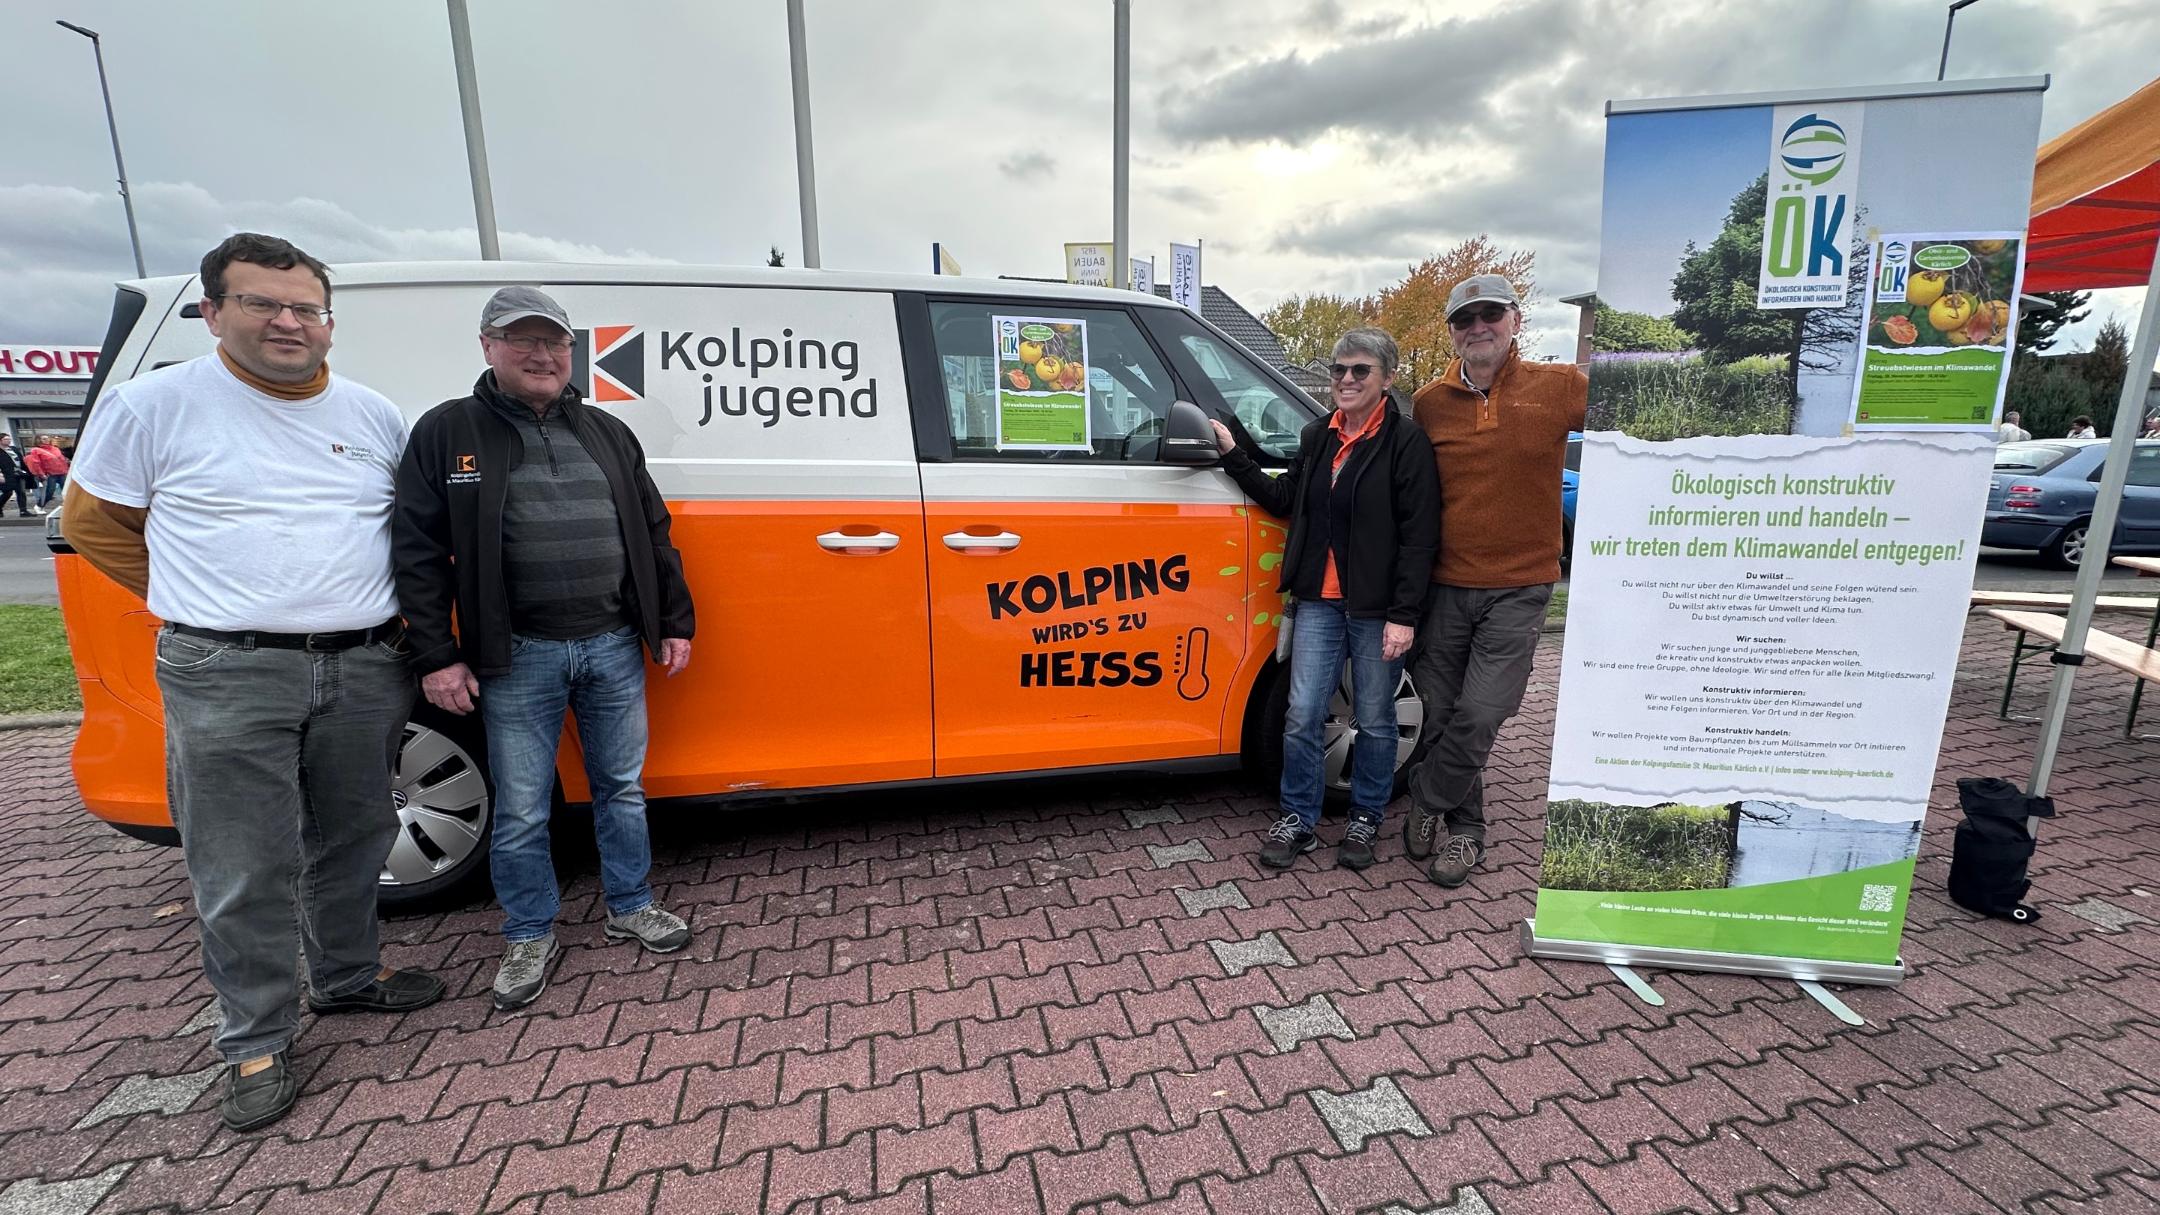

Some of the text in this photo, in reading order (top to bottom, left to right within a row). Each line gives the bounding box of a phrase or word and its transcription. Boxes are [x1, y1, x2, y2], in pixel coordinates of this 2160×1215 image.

[1767, 184, 1846, 278] ÖK
[1765, 284, 1842, 293] ÖKOLOGISCH KONSTRUKTIV
[1762, 295, 1802, 304] INFORMIEREN
[661, 327, 858, 381] Kolping
[698, 373, 877, 428] jugend
[1671, 469, 1895, 500] Ökologisch konstruktiv
[1649, 505, 1759, 527] informieren
[1766, 506, 1802, 527] und
[1809, 506, 1887, 528] handeln
[1590, 534, 1964, 566] wir treten dem Klimawandel entgegen!
[1746, 571, 1757, 580] Du
[1759, 572, 1783, 580] willst
[986, 554, 1190, 620] KOLPING
[1621, 579, 1633, 588] Du
[1633, 580, 1658, 588] willst
[1658, 581, 1679, 589] nicht
[1697, 581, 1717, 590] über
[1718, 582, 1734, 590] den
[1736, 582, 1790, 591] Klimawandel
[1833, 584, 1863, 594] Folgen
[1865, 585, 1898, 593] wütend
[1662, 591, 1673, 599] Du
[1675, 591, 1697, 600] willst
[1699, 592, 1719, 600] nicht
[1738, 593, 1751, 601] die
[1753, 593, 1830, 604] Umweltzerstörung
[1668, 602, 1680, 610] Du
[1681, 602, 1704, 610] willst
[1705, 603, 1726, 611] aktiv
[1727, 604, 1752, 612] etwas
[1754, 604, 1766, 612] für
[1768, 604, 1800, 613] Umwelt
[1802, 605, 1819, 613] und
[1821, 605, 1845, 614] Klima
[1691, 612, 1702, 621] Du
[1705, 613, 1719, 621] bist
[1722, 614, 1766, 623] dynamisch
[1768, 615, 1784, 623] und
[1786, 615, 1809, 623] voller
[1032, 612, 1147, 645] WIRD'S ZU
[1736, 635, 1751, 643] Wir
[1660, 643, 1675, 651] Wir
[1675, 644, 1706, 652] suchen
[1707, 646, 1730, 654] junge
[1749, 647, 1813, 656] junggebliebene
[1655, 653, 1667, 662] die
[1669, 654, 1697, 662] kreativ
[1699, 655, 1715, 663] und
[1716, 656, 1763, 664] konstruktiv
[1790, 659, 1830, 667] anpacken
[1020, 651, 1163, 688] HEISS
[1582, 660, 1597, 668] Wir
[1689, 665, 1710, 673] ohne
[1753, 666, 1769, 674] Wir
[1769, 668, 1787, 676] sind
[1788, 668, 1811, 676] offen
[1812, 668, 1825, 677] für
[1825, 669, 1842, 677] alle
[1702, 685, 1750, 694] Konstruktiv
[1644, 693, 1658, 701] Wir
[1659, 694, 1687, 702] wollen
[1705, 696, 1751, 705] konstruktiv
[1753, 698, 1772, 706] über
[1774, 698, 1789, 706] den
[1791, 699, 1844, 708] Klimawandel
[1846, 701, 1862, 709] und
[1647, 704, 1668, 712] seine
[1670, 704, 1697, 714] Folgen
[1751, 707, 1765, 715] Vor
[1767, 708, 1780, 716] Ort
[1782, 709, 1798, 717] und
[1809, 710, 1824, 718] der
[1705, 726, 1753, 735] Konstruktiv
[1592, 730, 1605, 738] Wir
[1634, 732, 1668, 742] Projekte
[1688, 735, 1745, 745] Baumpflanzen
[1748, 738, 1760, 746] bis
[1781, 739, 1837, 749] Müllsammeln
[1854, 741, 1867, 750] Ort
[1663, 744, 1678, 752] und
[1680, 746, 1736, 754] internationale
[1737, 747, 1772, 757] Projekte
